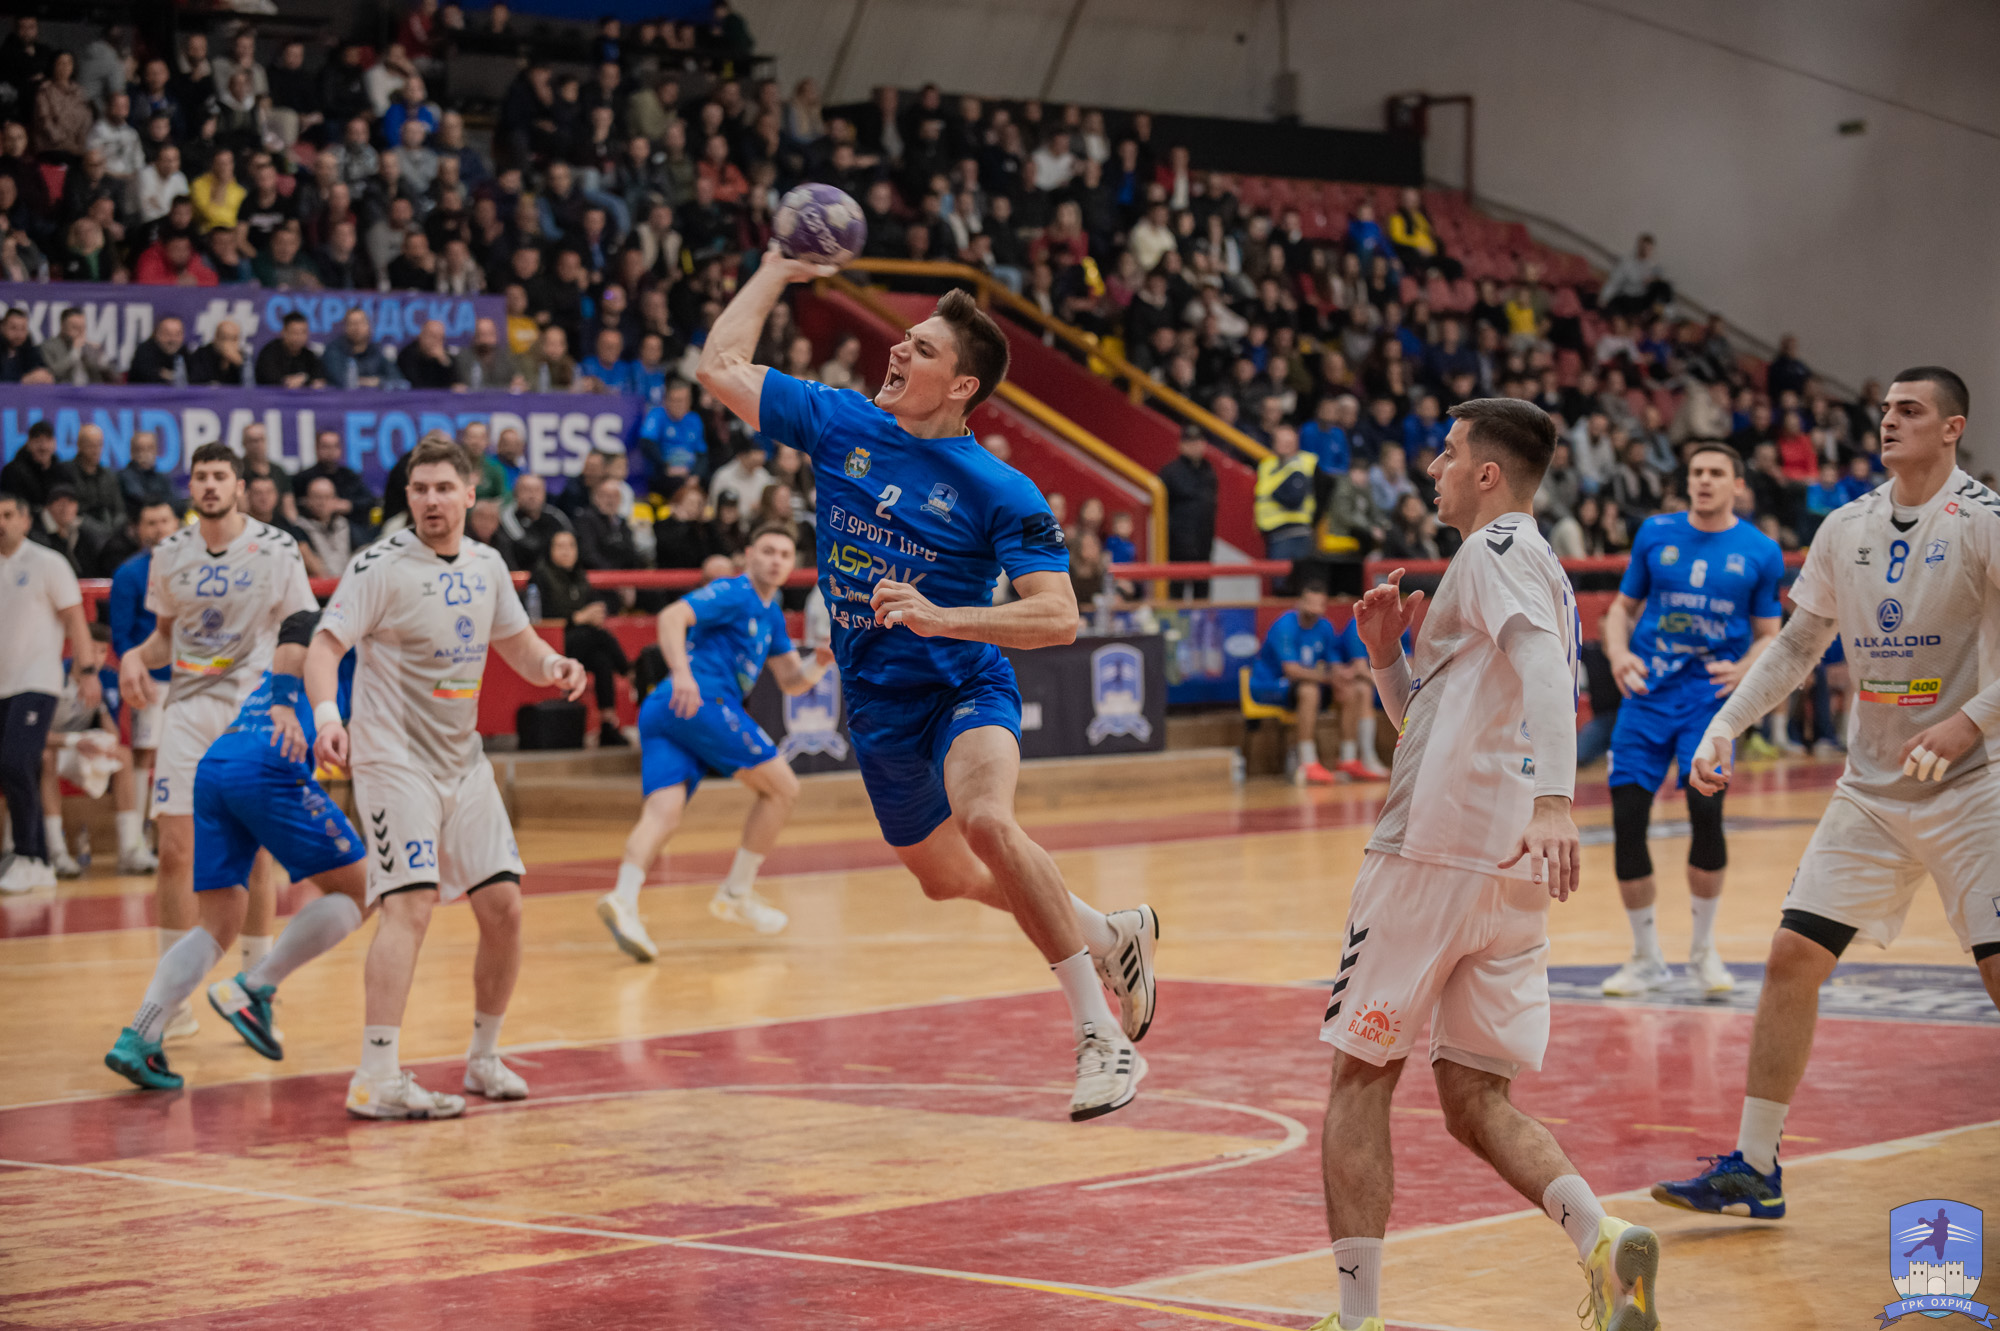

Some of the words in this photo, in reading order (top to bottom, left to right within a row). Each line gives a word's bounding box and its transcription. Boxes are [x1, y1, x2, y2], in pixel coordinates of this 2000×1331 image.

[875, 484, 902, 521] 2
[1886, 539, 1910, 584] 8
[196, 564, 229, 597] 25
[439, 572, 472, 606] 23
[1854, 635, 1941, 648] ALKALOID
[1870, 650, 1914, 658] SKOPJE
[1912, 681, 1938, 692] 400
[405, 840, 436, 869] 23
[1348, 1019, 1396, 1048] BLACKUP
